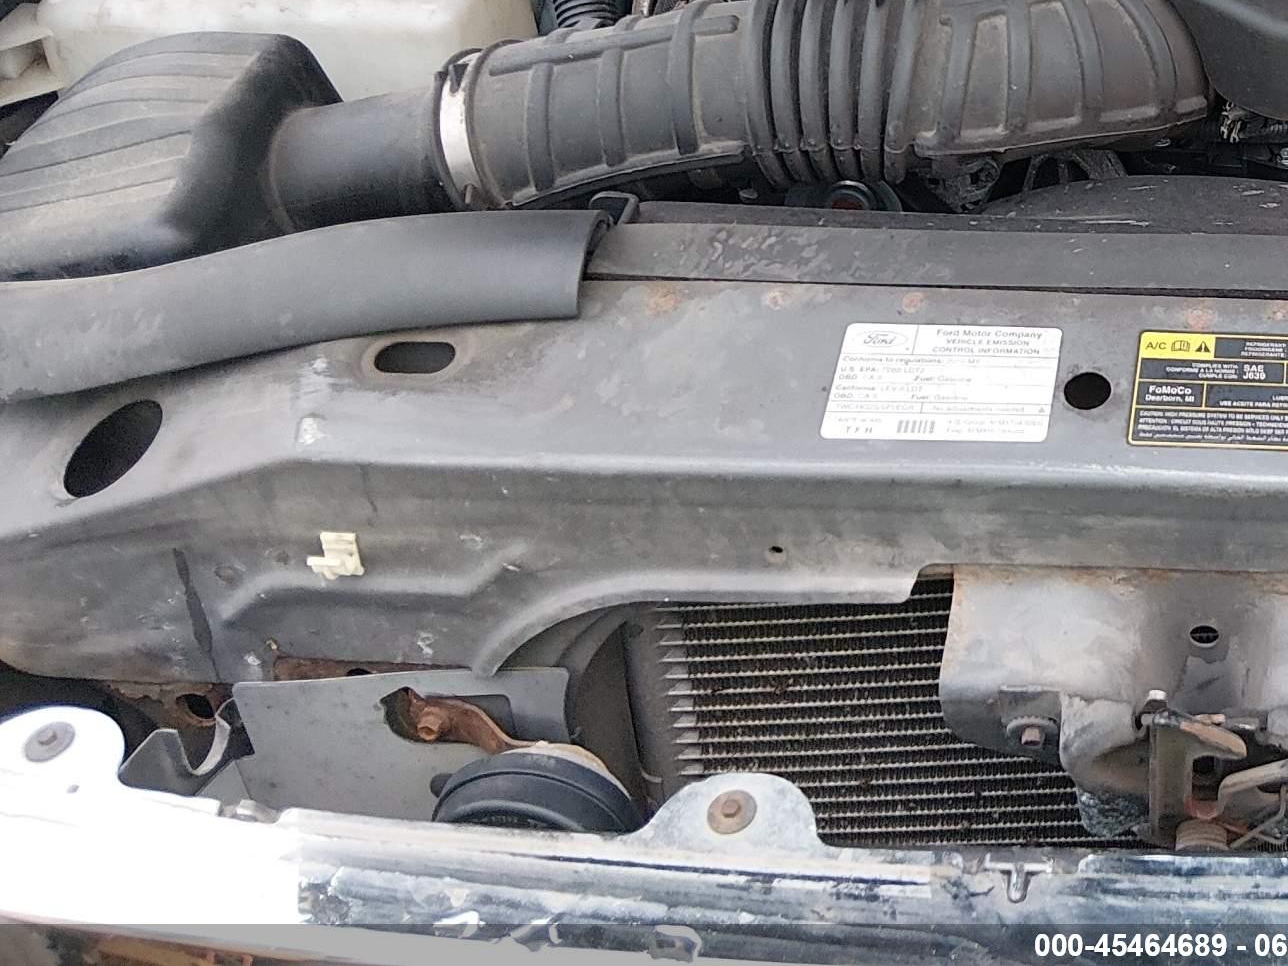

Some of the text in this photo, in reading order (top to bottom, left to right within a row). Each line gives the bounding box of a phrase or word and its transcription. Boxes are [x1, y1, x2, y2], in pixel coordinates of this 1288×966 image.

[995, 330, 1043, 339] Company
[863, 334, 897, 345] Ford
[1145, 341, 1167, 351] A/C
[1243, 364, 1264, 372] SAE
[1242, 372, 1266, 380] J639
[1148, 385, 1192, 394] FoMoCo
[1145, 394, 1183, 403] Dearborn,
